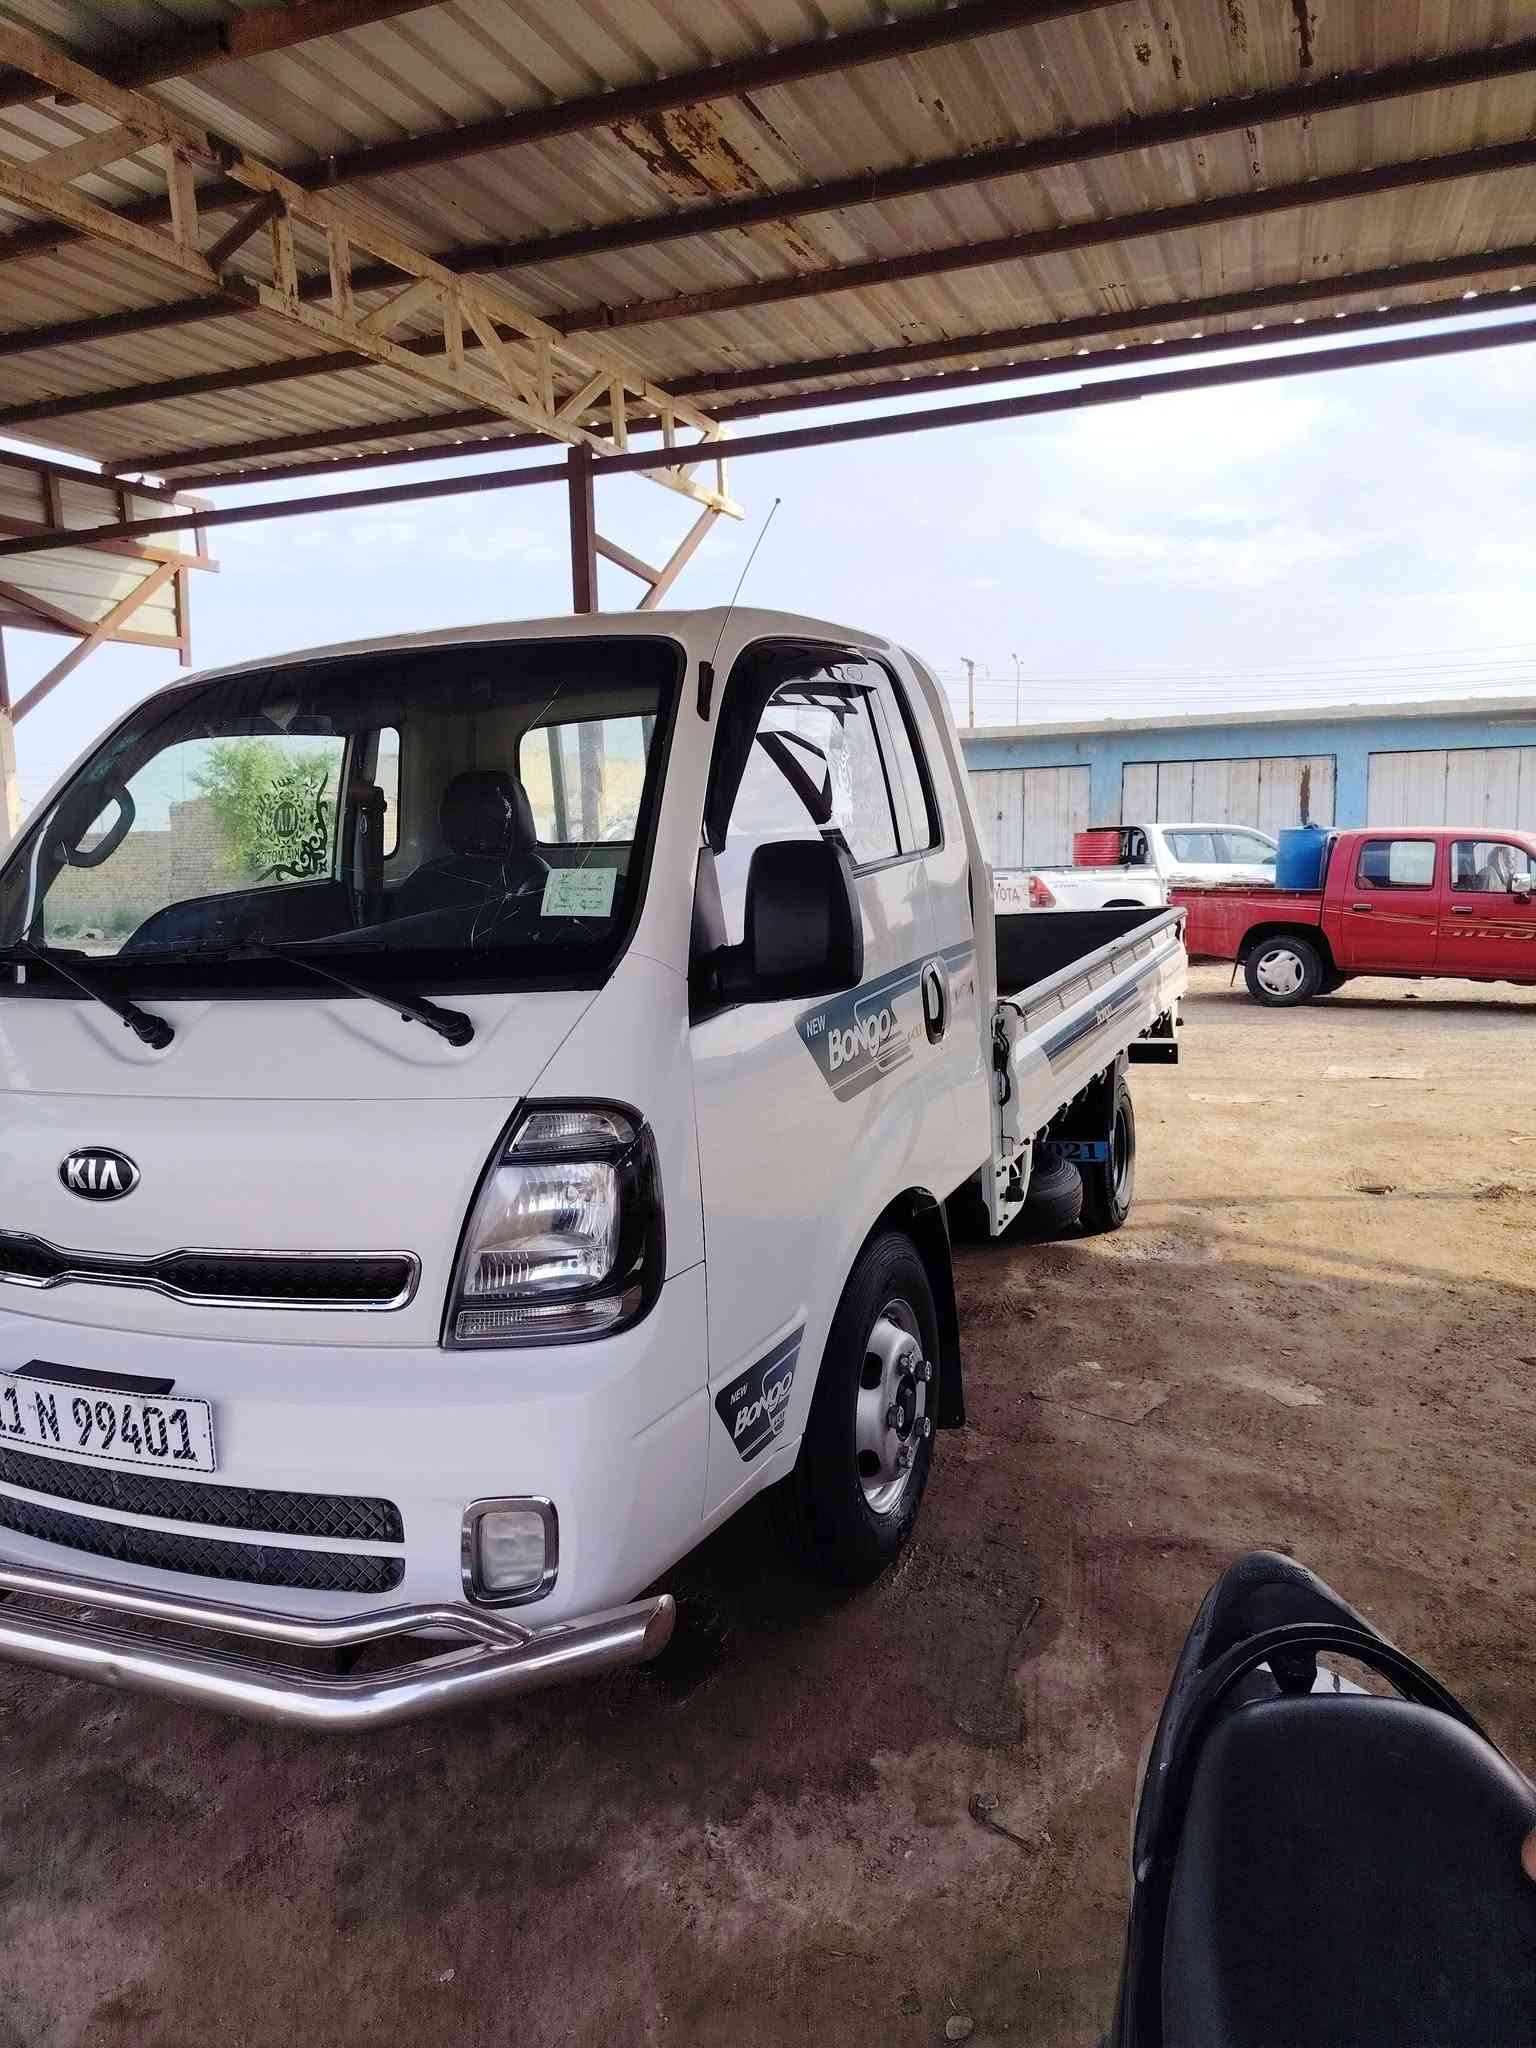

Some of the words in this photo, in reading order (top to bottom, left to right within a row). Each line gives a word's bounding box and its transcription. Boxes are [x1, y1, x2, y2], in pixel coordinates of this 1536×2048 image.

[993, 887, 1019, 902] YOTA
[806, 1014, 826, 1039] NEW
[67, 1157, 123, 1190] KIA
[730, 1382, 748, 1406] NEW
[0, 1387, 25, 1434] 1
[35, 1391, 60, 1442] N
[72, 1397, 198, 1462] 99401
